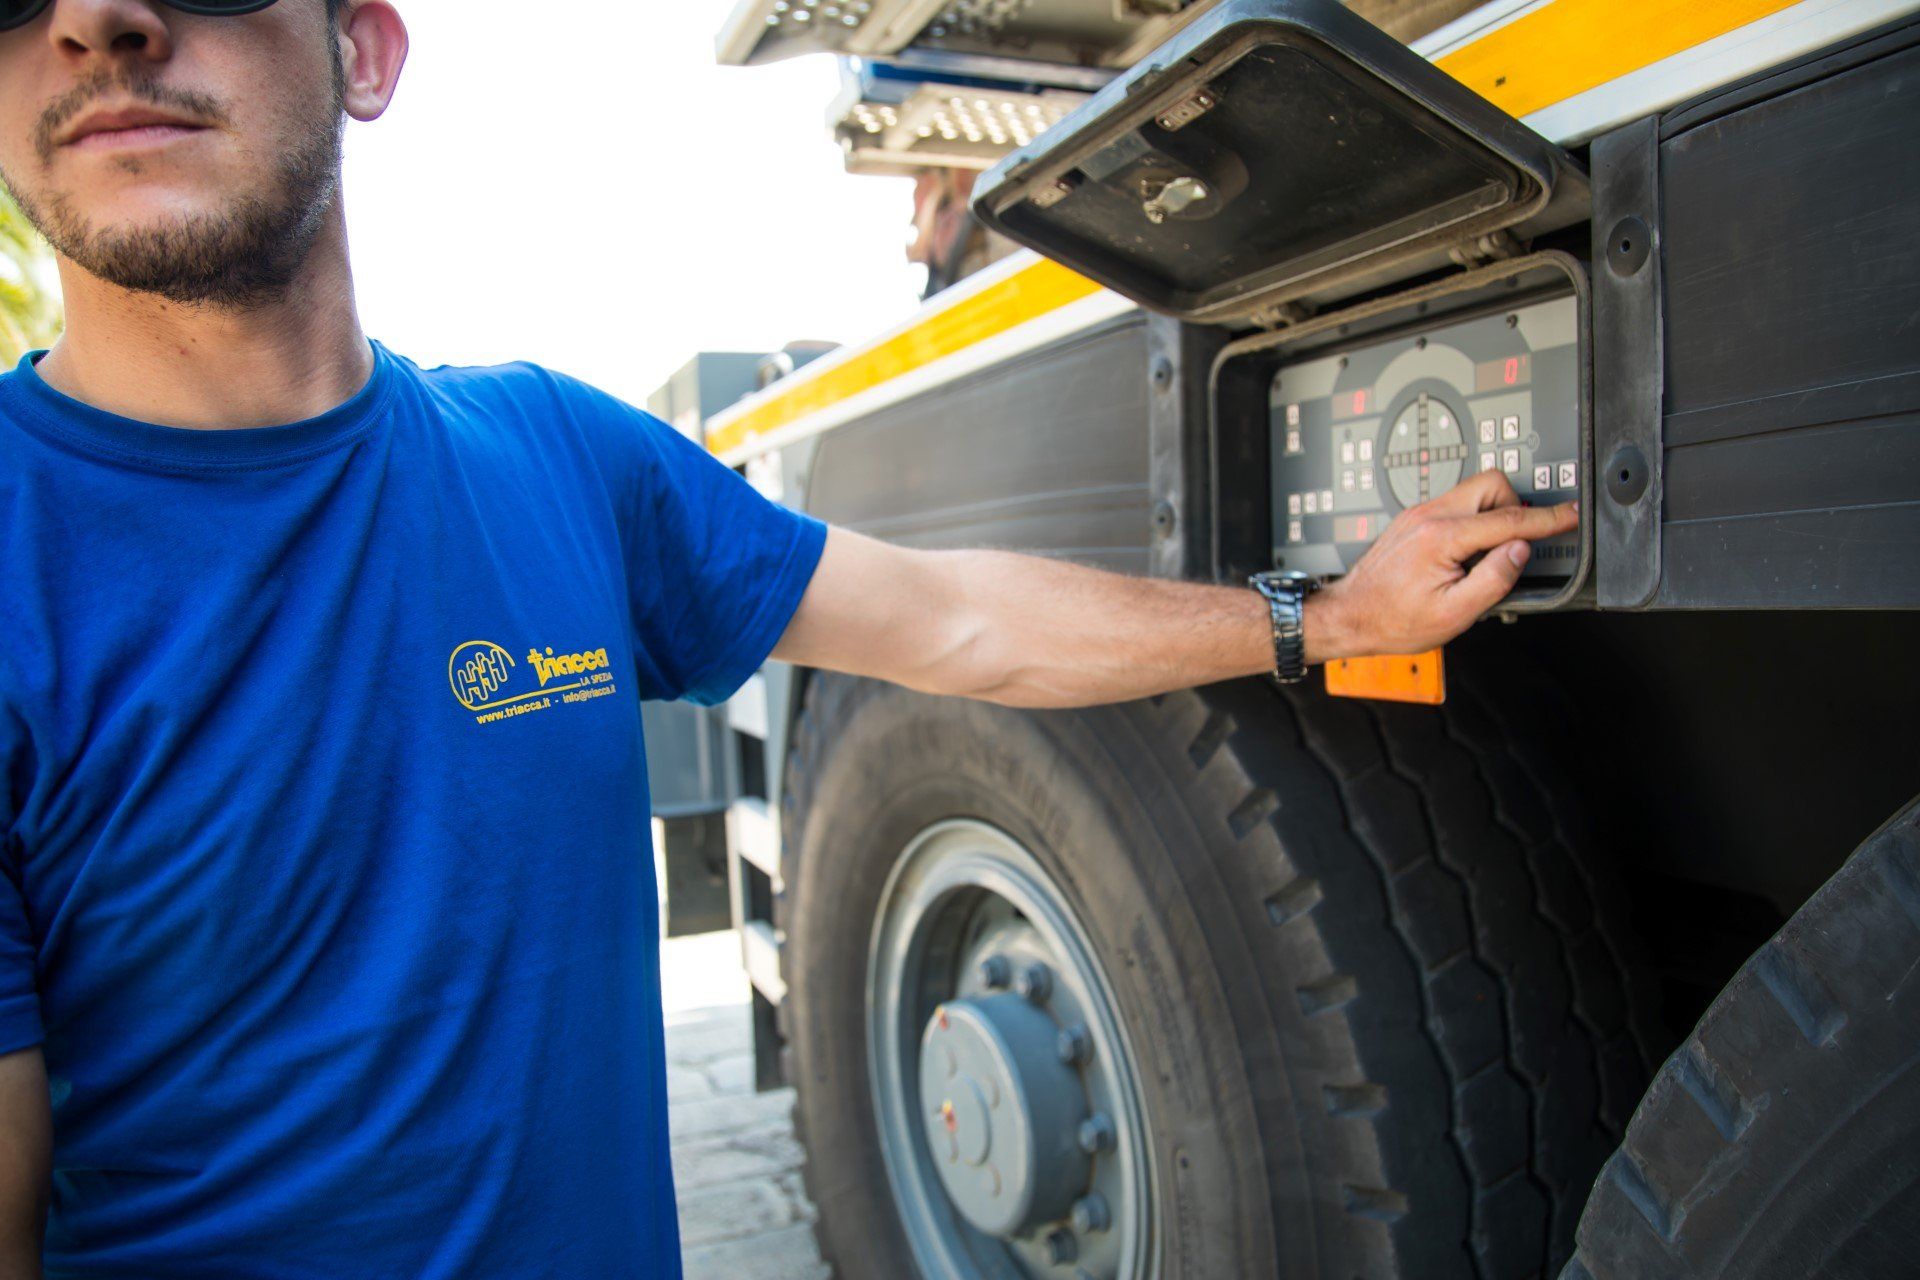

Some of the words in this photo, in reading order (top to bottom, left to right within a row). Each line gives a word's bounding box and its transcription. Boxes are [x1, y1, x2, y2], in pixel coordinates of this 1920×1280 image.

[527, 646, 609, 687] triacca
[580, 676, 591, 686] LA
[476, 697, 551, 725] www.triacca.it
[562, 684, 617, 703] info@triacca.it
